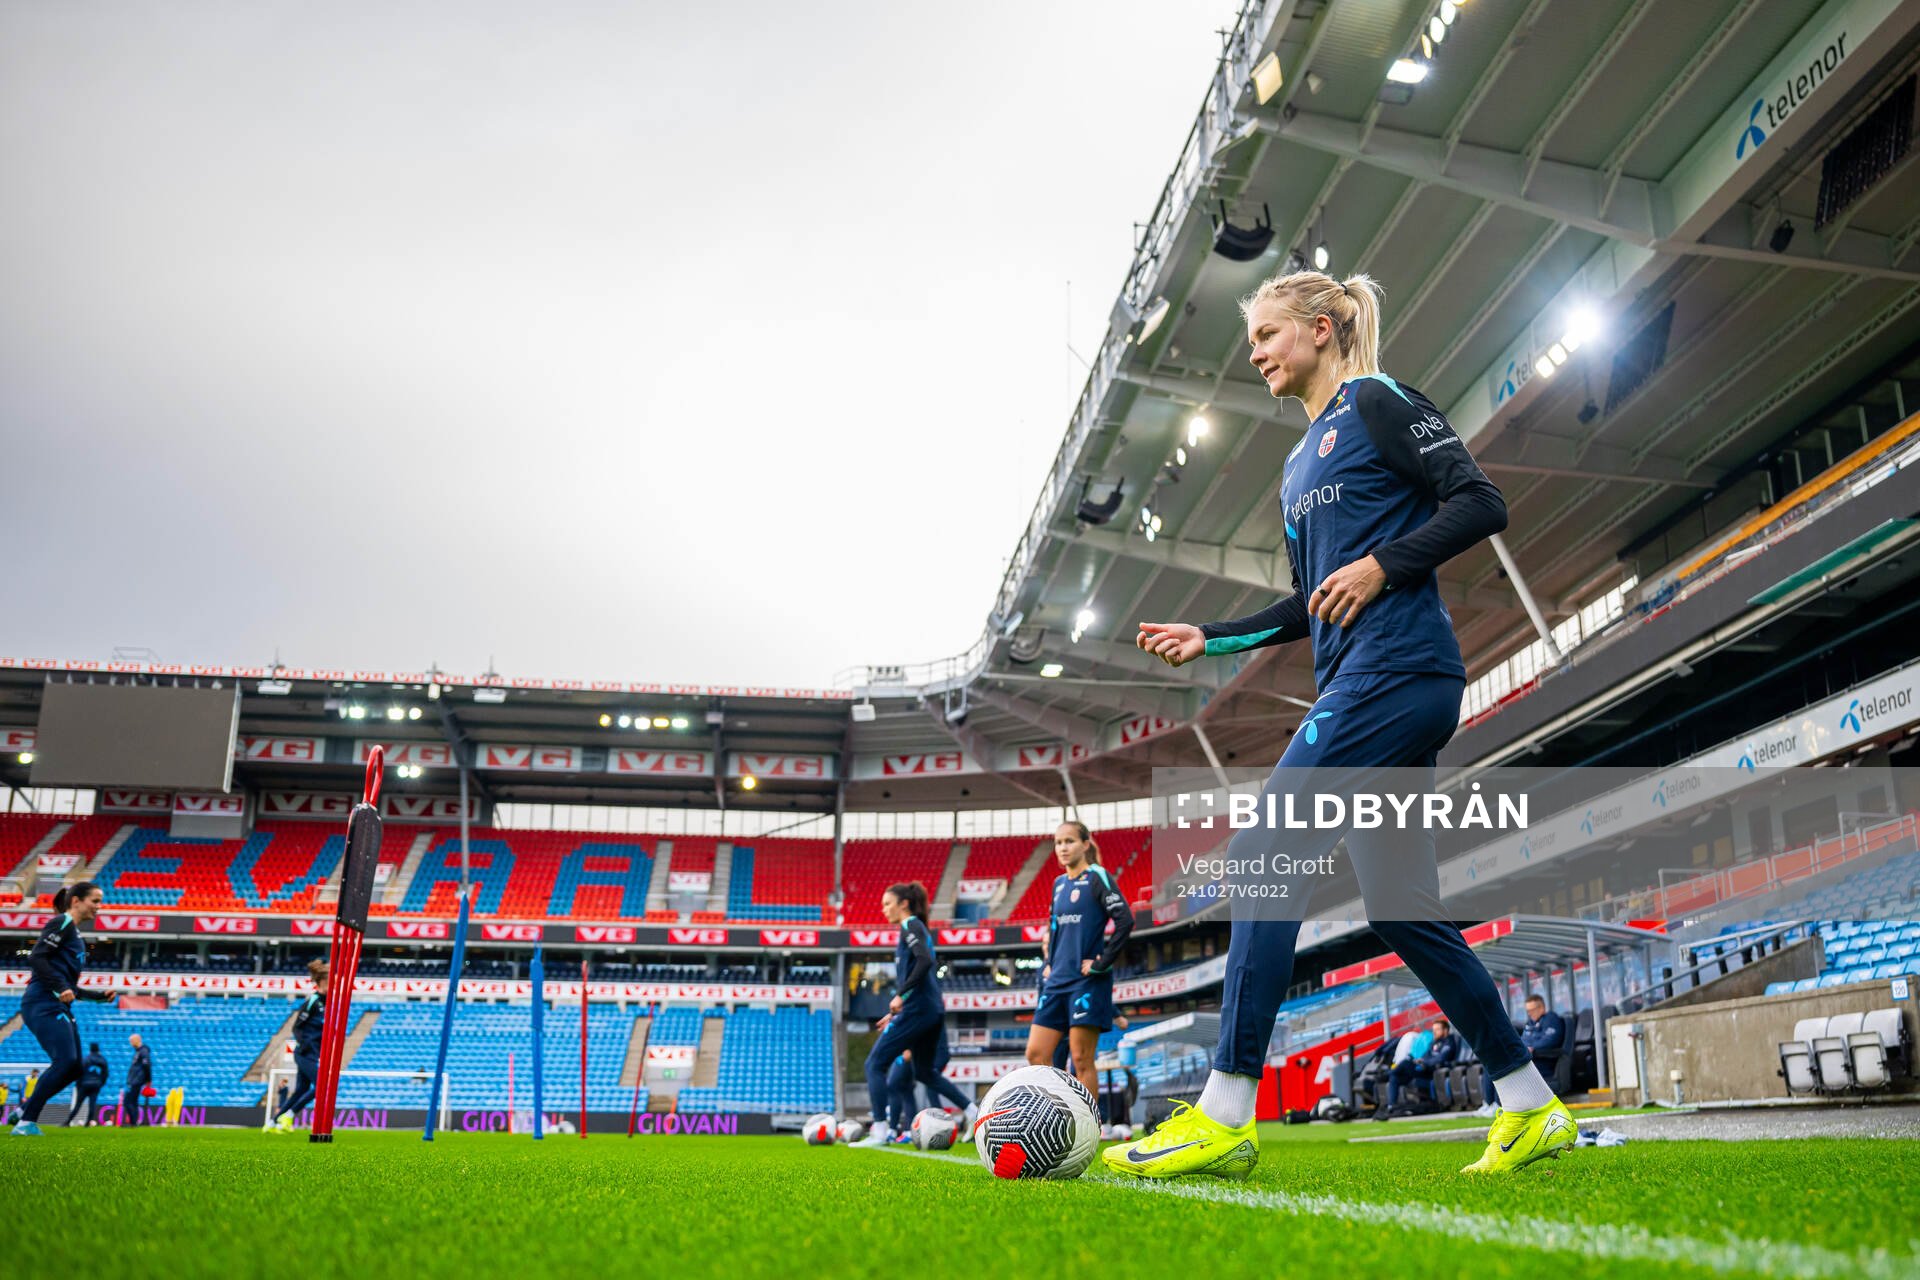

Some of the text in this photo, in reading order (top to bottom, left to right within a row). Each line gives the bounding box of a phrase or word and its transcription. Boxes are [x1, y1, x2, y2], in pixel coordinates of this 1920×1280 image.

[1767, 31, 1846, 128] telenor
[1409, 413, 1444, 439] DNB
[1291, 483, 1344, 523] telenor
[1859, 686, 1912, 722] telenor
[488, 748, 571, 769] VG
[1754, 733, 1797, 766] telenor
[620, 752, 704, 773] VG
[740, 755, 822, 776] VG
[884, 753, 962, 774] VG
[105, 791, 169, 808] VG
[177, 797, 242, 813] VG
[270, 794, 350, 816] VG
[387, 797, 472, 818] VG
[99, 916, 157, 931] VG
[197, 918, 255, 932] VG
[390, 923, 448, 938] VG
[484, 926, 541, 940] VG
[578, 927, 634, 942] VG
[671, 929, 727, 943] VG
[762, 931, 818, 945] VG
[941, 930, 993, 945] VG
[124, 976, 170, 987] VG
[181, 977, 227, 988] VG
[239, 979, 284, 989] VG
[353, 981, 396, 992] VG
[462, 984, 505, 994] VG
[625, 987, 668, 997] VG
[679, 987, 722, 998] VG
[733, 988, 776, 999] VG
[786, 989, 829, 999] VG
[974, 995, 1016, 1008] VG
[98, 1105, 206, 1126] GVNI
[637, 1112, 738, 1135] GIOVANI
